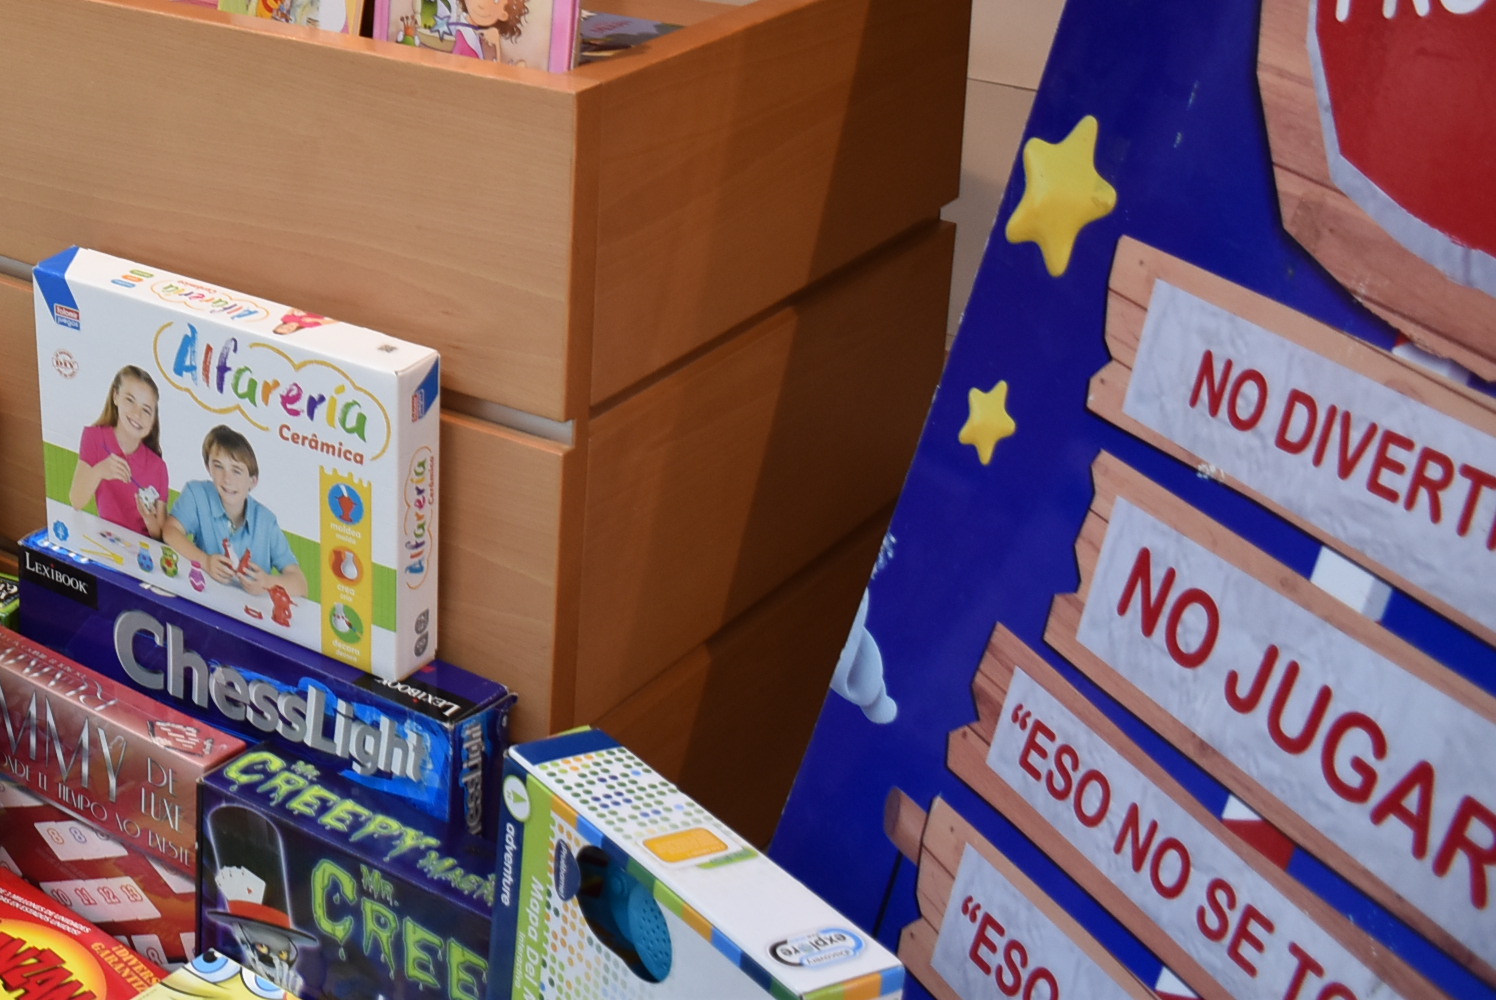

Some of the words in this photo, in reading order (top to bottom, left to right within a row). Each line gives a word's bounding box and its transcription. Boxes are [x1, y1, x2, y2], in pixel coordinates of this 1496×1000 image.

[173, 322, 367, 442] Alfarería
[1189, 349, 1268, 431] NO
[278, 423, 364, 465] Cerâmica
[113, 609, 428, 783] ChessLight
[1117, 547, 1220, 669] NO
[1224, 643, 1496, 909] JUGAR
[58, 781, 108, 821] TIEMPO
[141, 787, 182, 832] LUXE
[147, 757, 177, 796] DE
[224, 752, 441, 861] CREEPY
[47, 827, 64, 844] 8
[69, 826, 87, 844] 8
[501, 822, 516, 906] adventure
[526, 876, 544, 941] Mapa
[1114, 801, 1191, 899] NO
[1196, 877, 1275, 979] SE
[525, 945, 539, 987] Del
